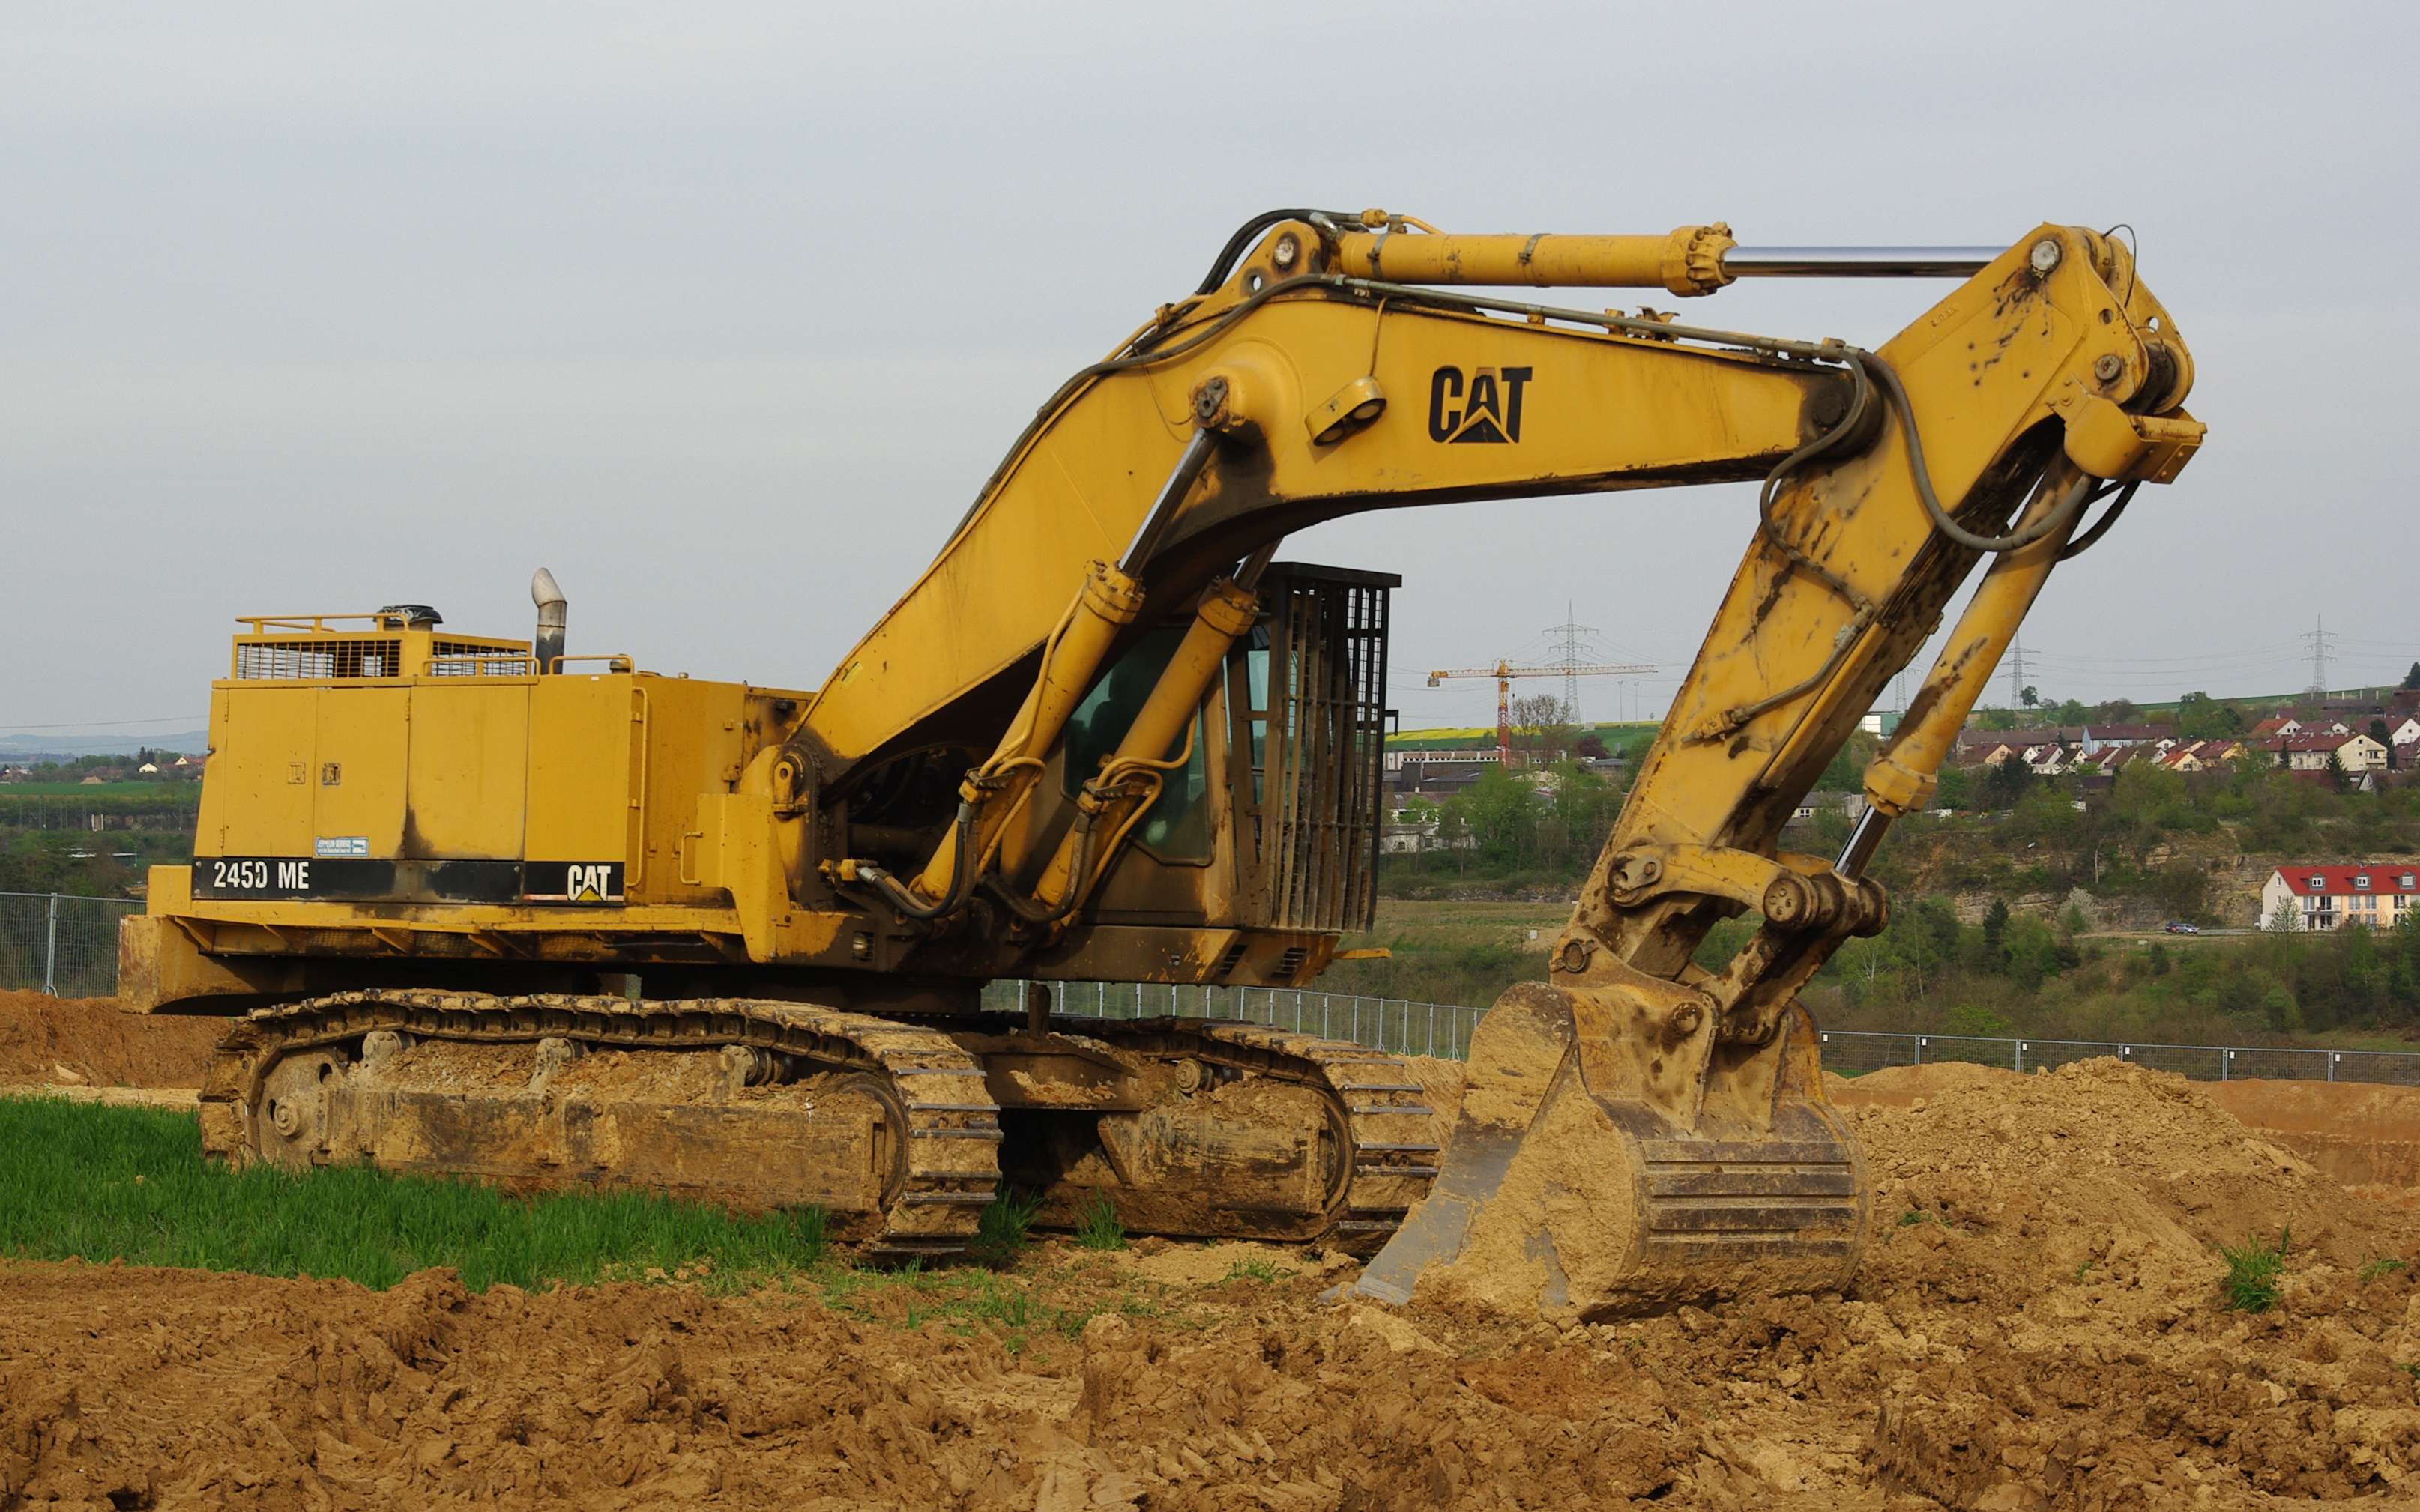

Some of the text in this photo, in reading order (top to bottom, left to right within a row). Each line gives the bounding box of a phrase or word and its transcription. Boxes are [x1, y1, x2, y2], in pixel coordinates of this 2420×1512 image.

[1428, 365, 1533, 444] CAT
[214, 861, 309, 889] 245D ME
[567, 865, 612, 901] CAT
